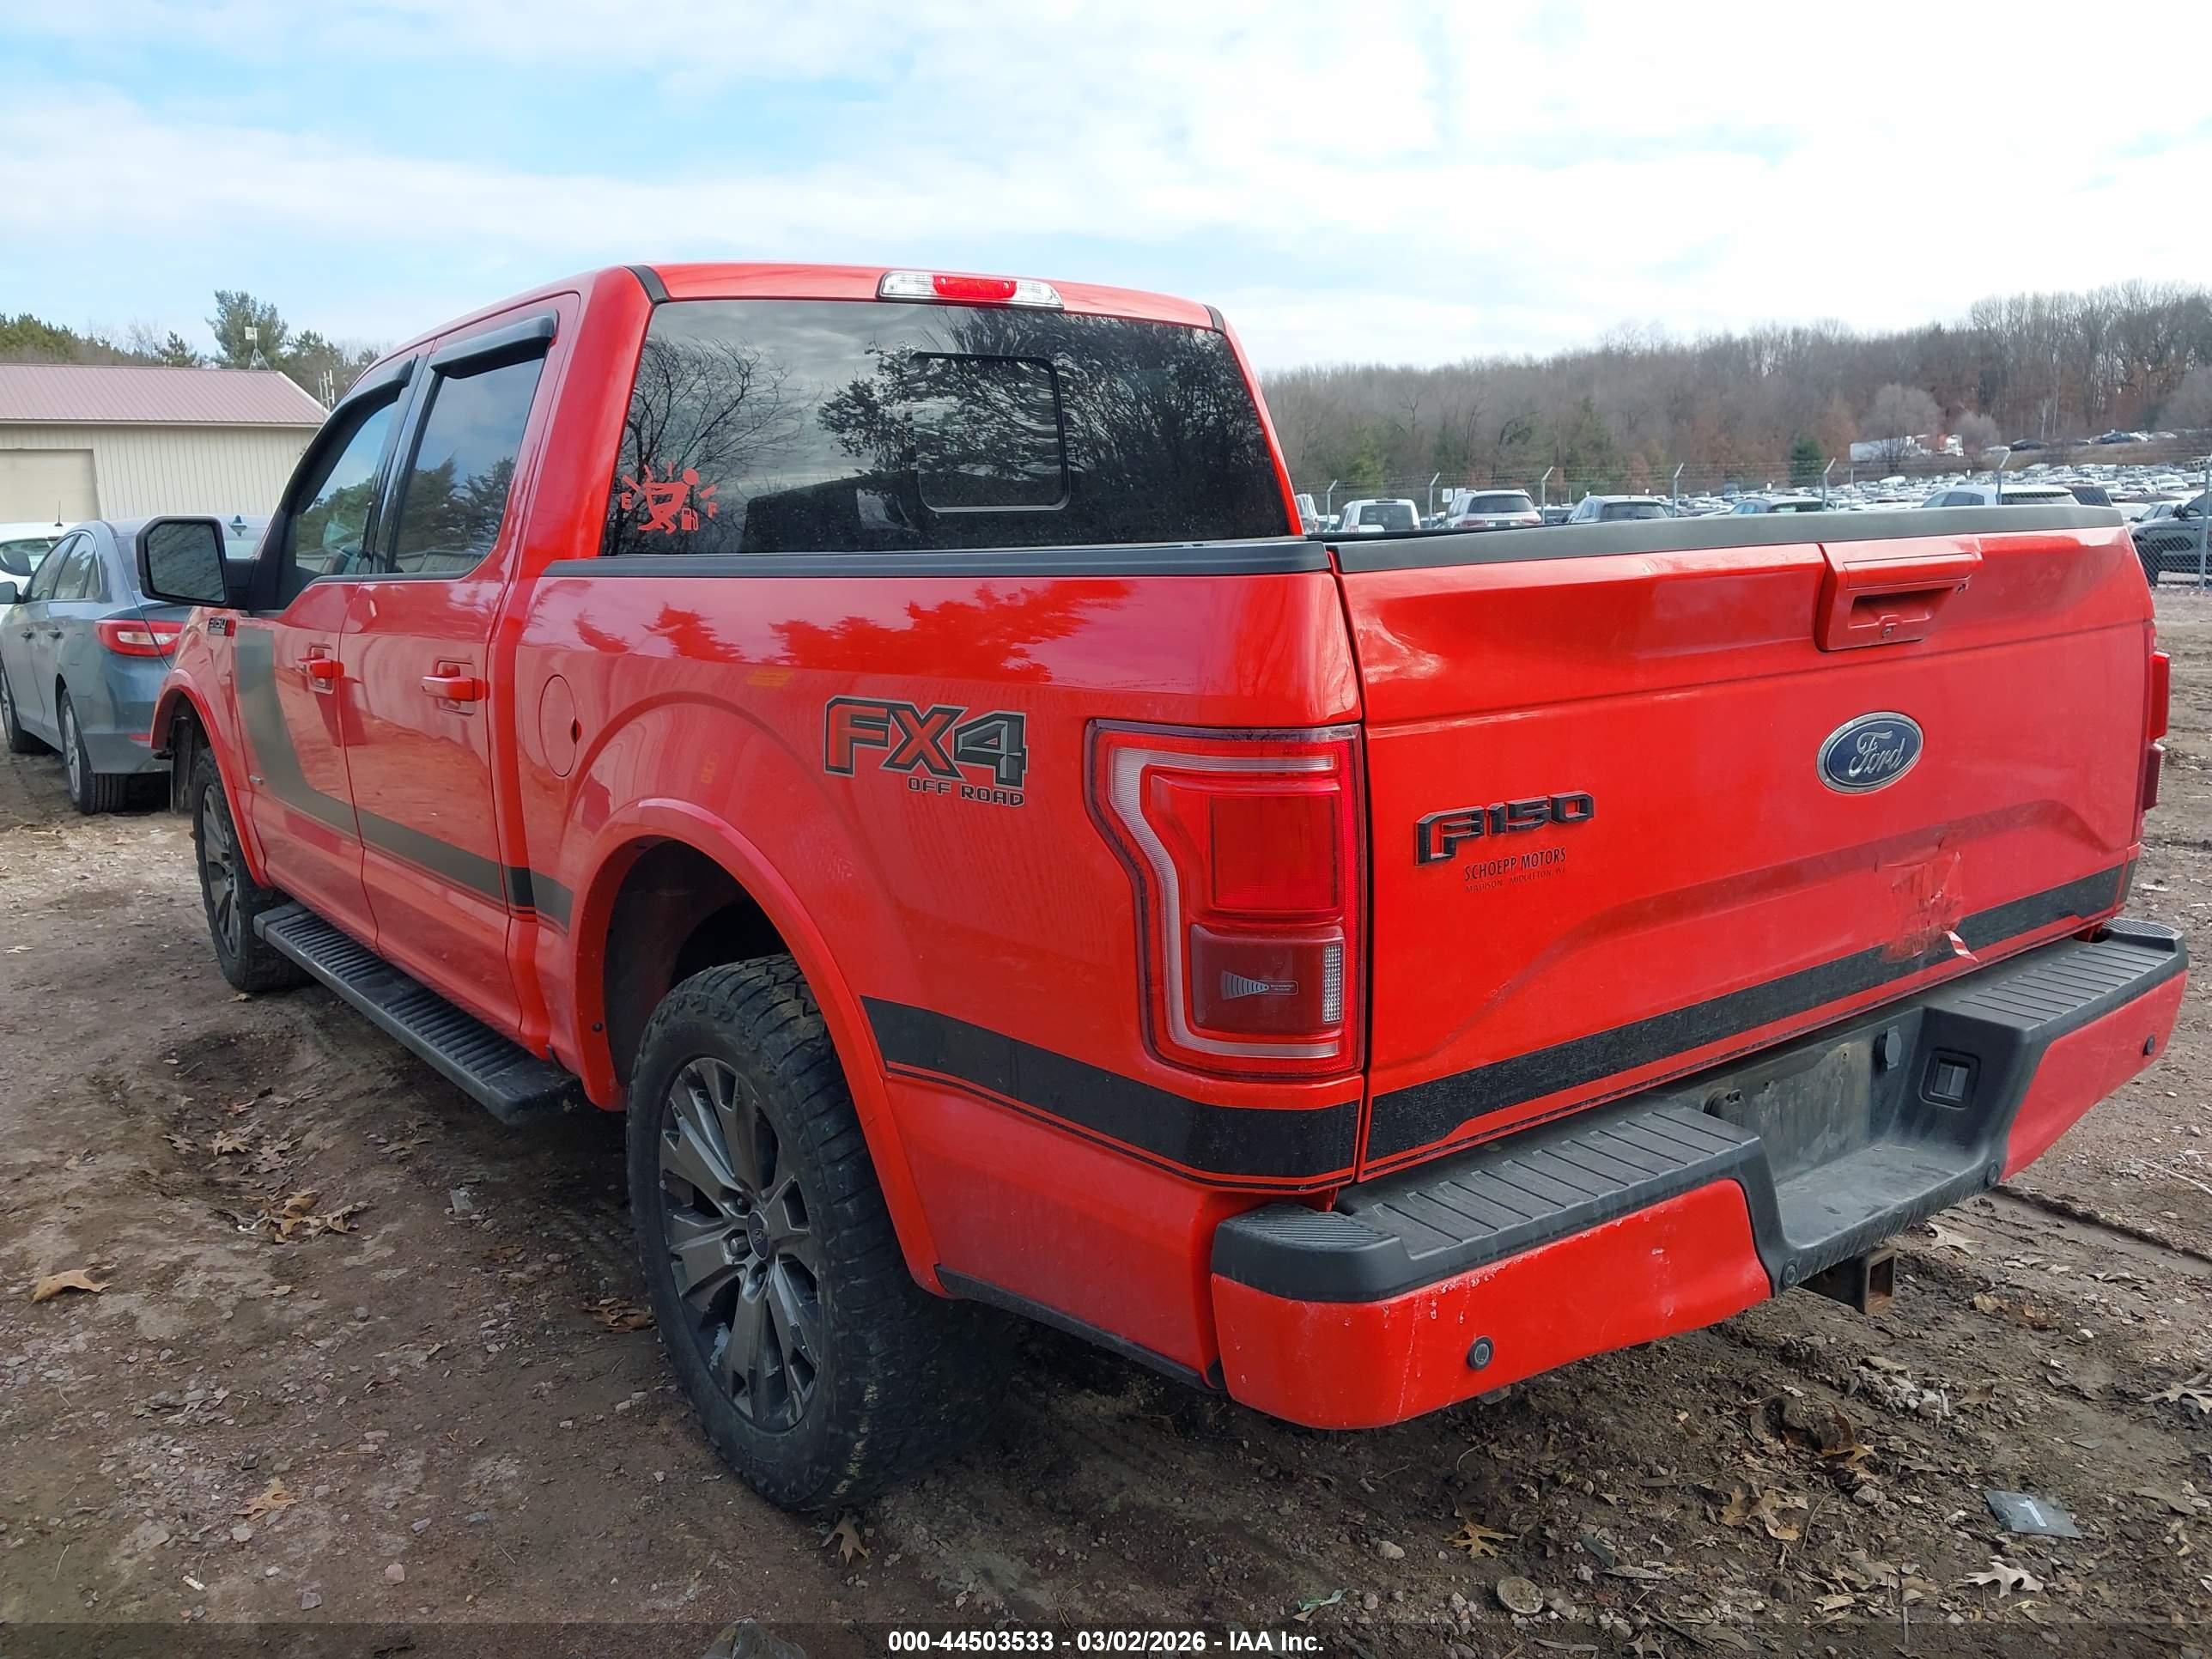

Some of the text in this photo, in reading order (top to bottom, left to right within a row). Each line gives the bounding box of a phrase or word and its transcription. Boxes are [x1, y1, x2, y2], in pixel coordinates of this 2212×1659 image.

[824, 694, 1029, 789] FX4
[907, 775, 1024, 807] OFF ROAD
[1415, 790, 1595, 867] F150
[1464, 846, 1567, 882] SCHOEPP MOTORS
